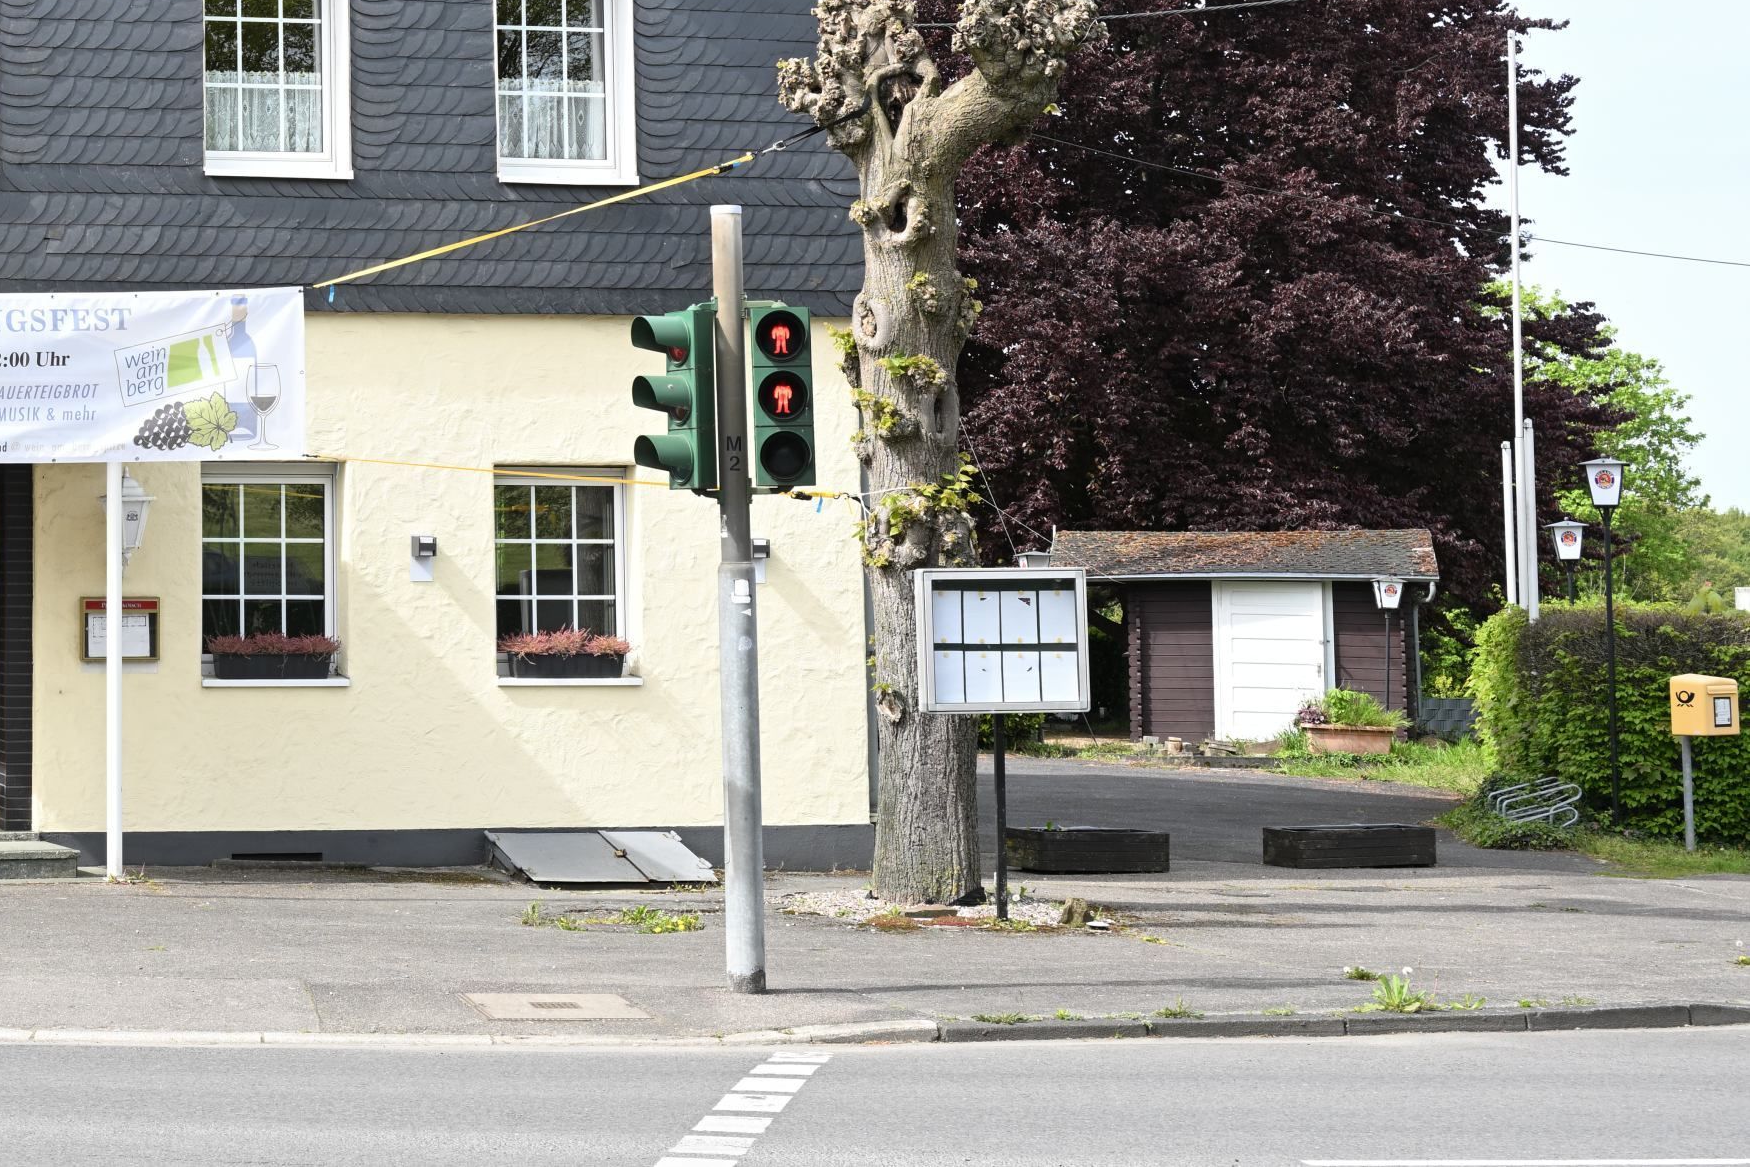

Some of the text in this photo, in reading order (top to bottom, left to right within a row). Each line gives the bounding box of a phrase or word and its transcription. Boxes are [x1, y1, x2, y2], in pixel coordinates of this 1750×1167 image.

[36, 351, 70, 367] Uhr
[124, 345, 167, 369] wein
[136, 361, 165, 380] am
[126, 376, 164, 397] berg
[46, 407, 56, 421] &
[62, 404, 97, 421] mehr
[726, 435, 742, 451] M
[729, 455, 741, 472] 2
